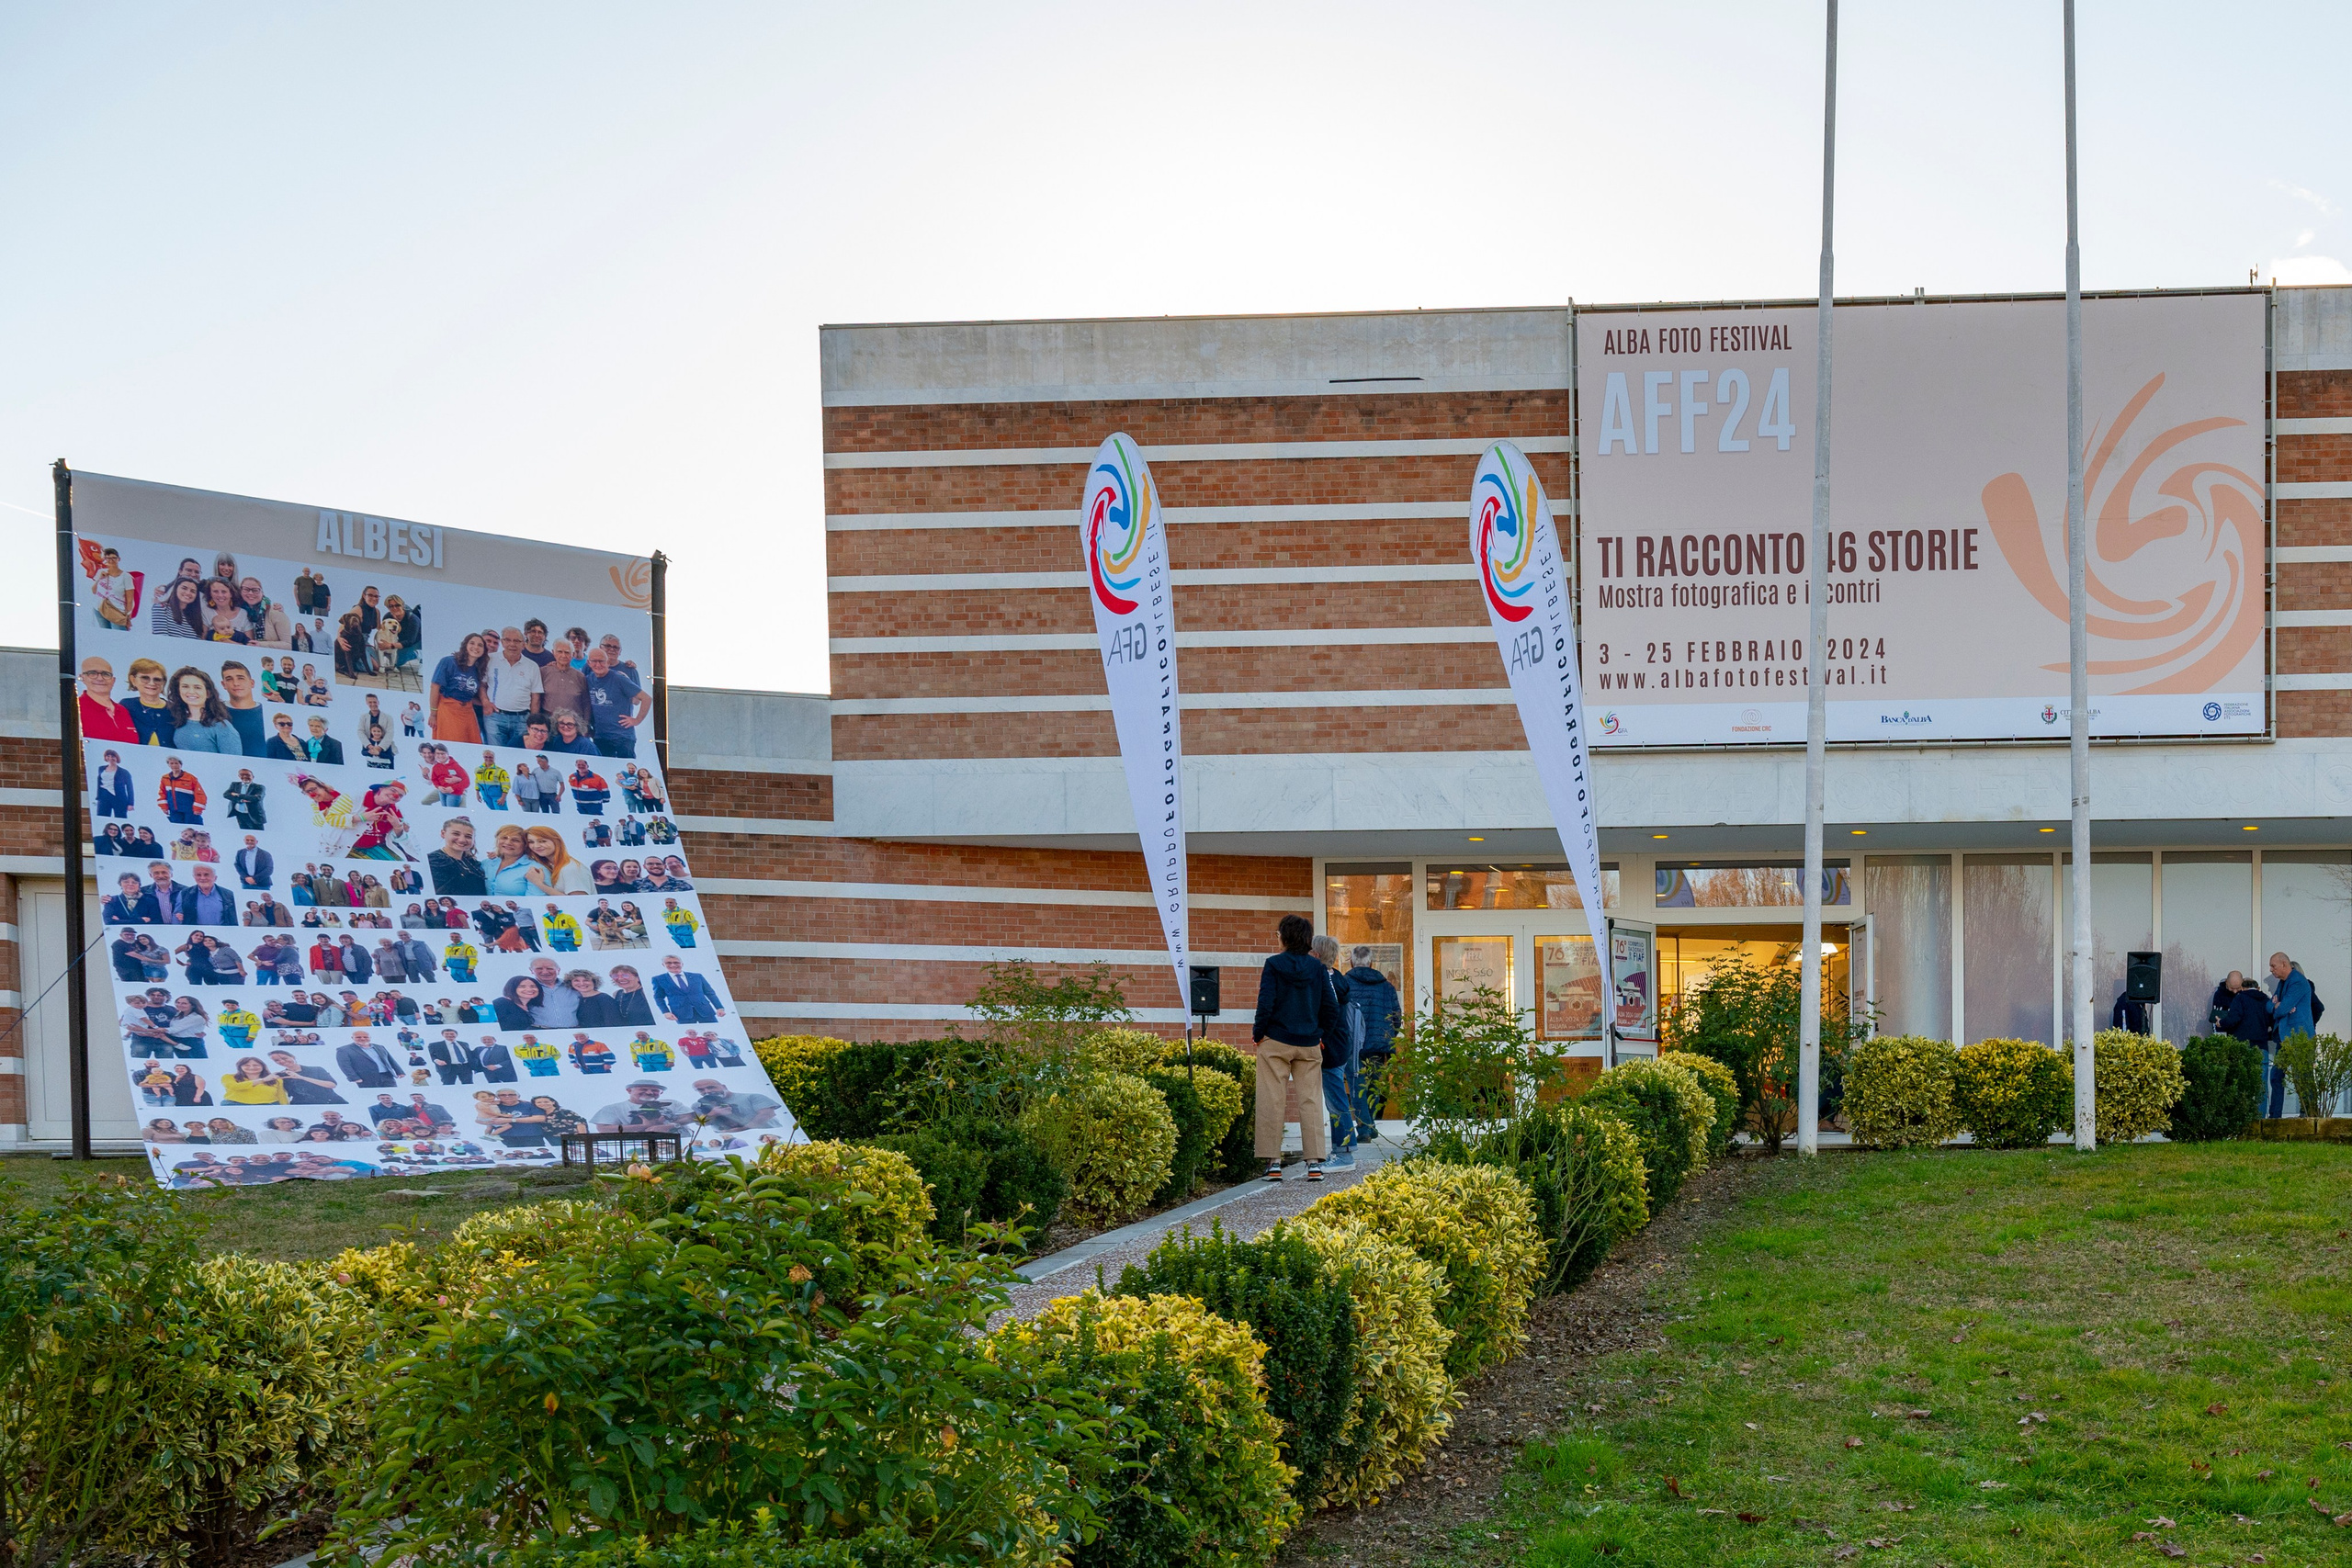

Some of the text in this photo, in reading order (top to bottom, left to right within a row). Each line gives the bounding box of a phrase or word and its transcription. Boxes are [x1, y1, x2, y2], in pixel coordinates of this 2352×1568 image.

[1604, 324, 1792, 355] ALBA FOTO FESTIVAL
[1597, 367, 1797, 456] AFF24
[316, 510, 444, 569] ALBESI
[1598, 536, 1623, 578] TI
[1636, 532, 1805, 578] RACCONTO
[1868, 528, 1979, 572] STORIE
[1599, 578, 1881, 609] Mostra fotografica e icontri
[1600, 643, 1610, 664] 3
[1646, 641, 1672, 664] 25
[1687, 638, 1803, 663] FEBBRAIO
[1826, 637, 1886, 660] 2024
[1600, 664, 1888, 690] www.albafotofestval.it
